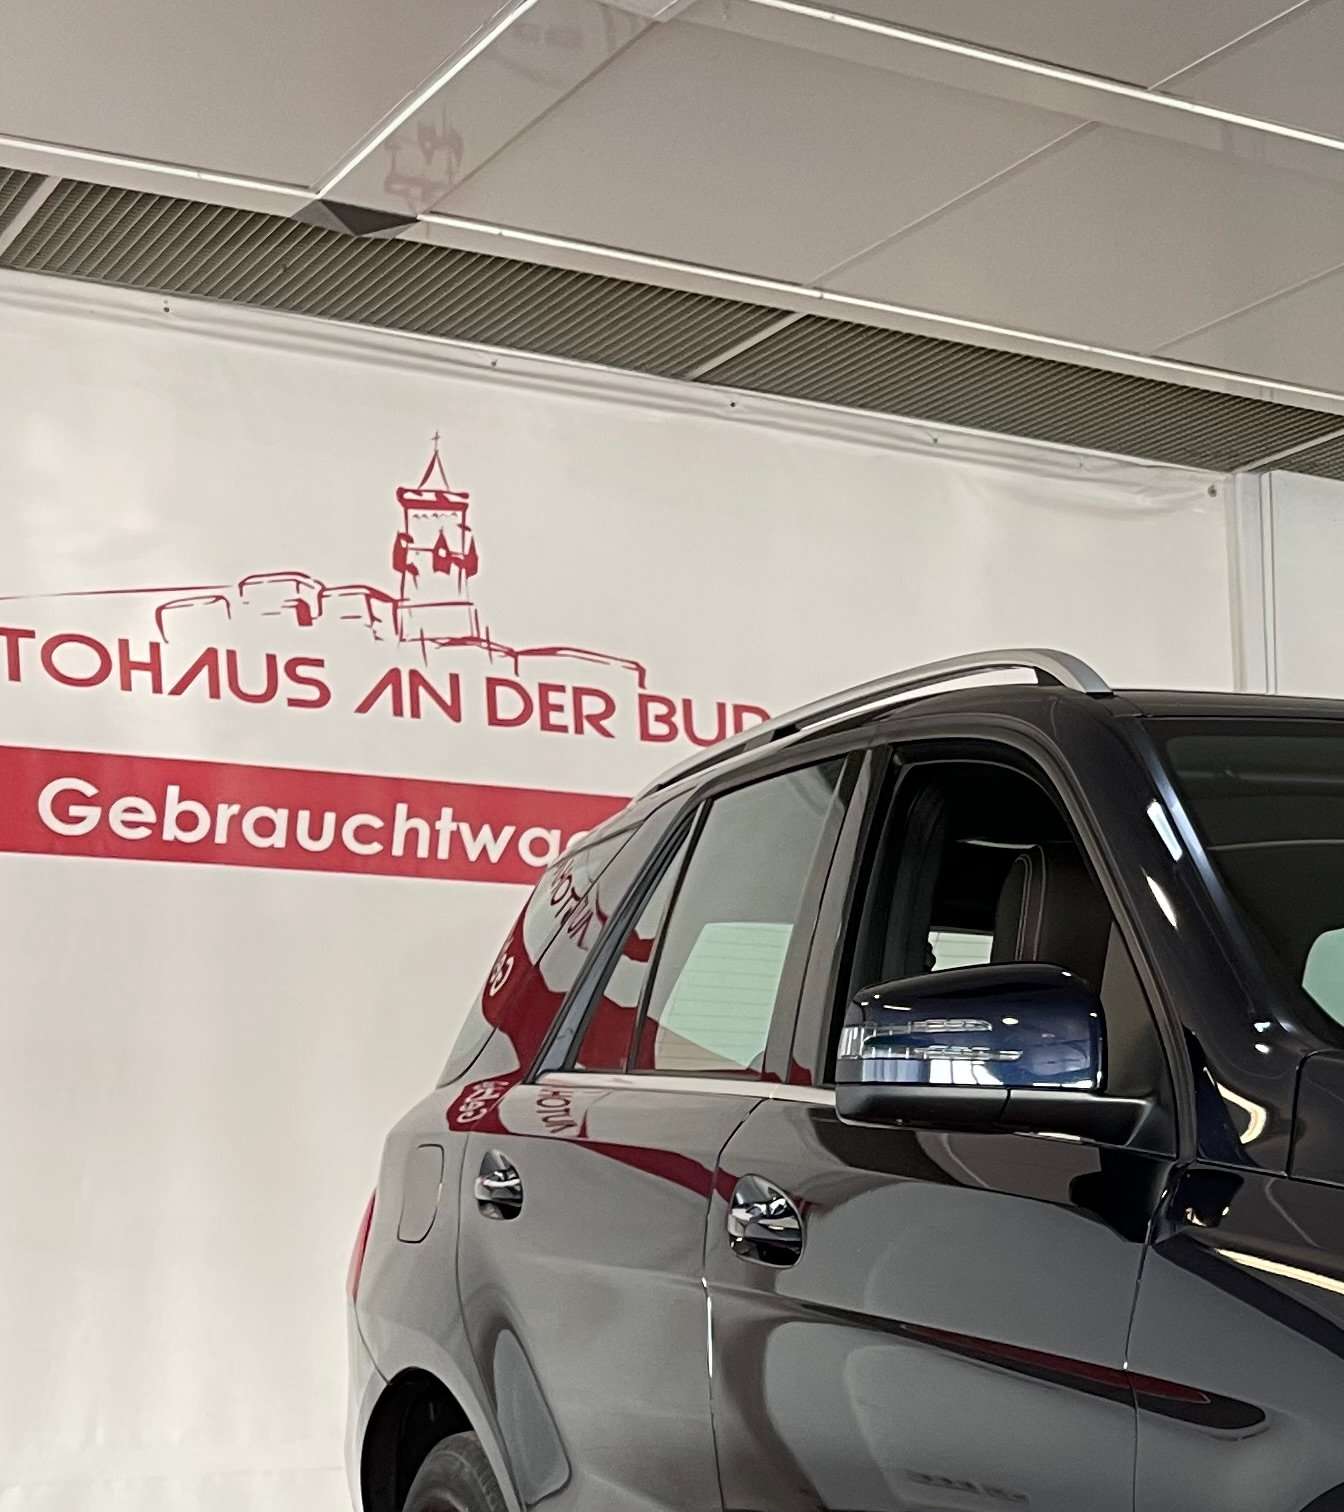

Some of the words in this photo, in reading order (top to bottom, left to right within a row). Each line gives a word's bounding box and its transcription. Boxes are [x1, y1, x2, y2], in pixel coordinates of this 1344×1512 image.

[0, 626, 331, 708] TOHAUS
[354, 667, 460, 722] AN
[486, 676, 616, 738] DER
[38, 777, 589, 868] Gebrauchtwa
